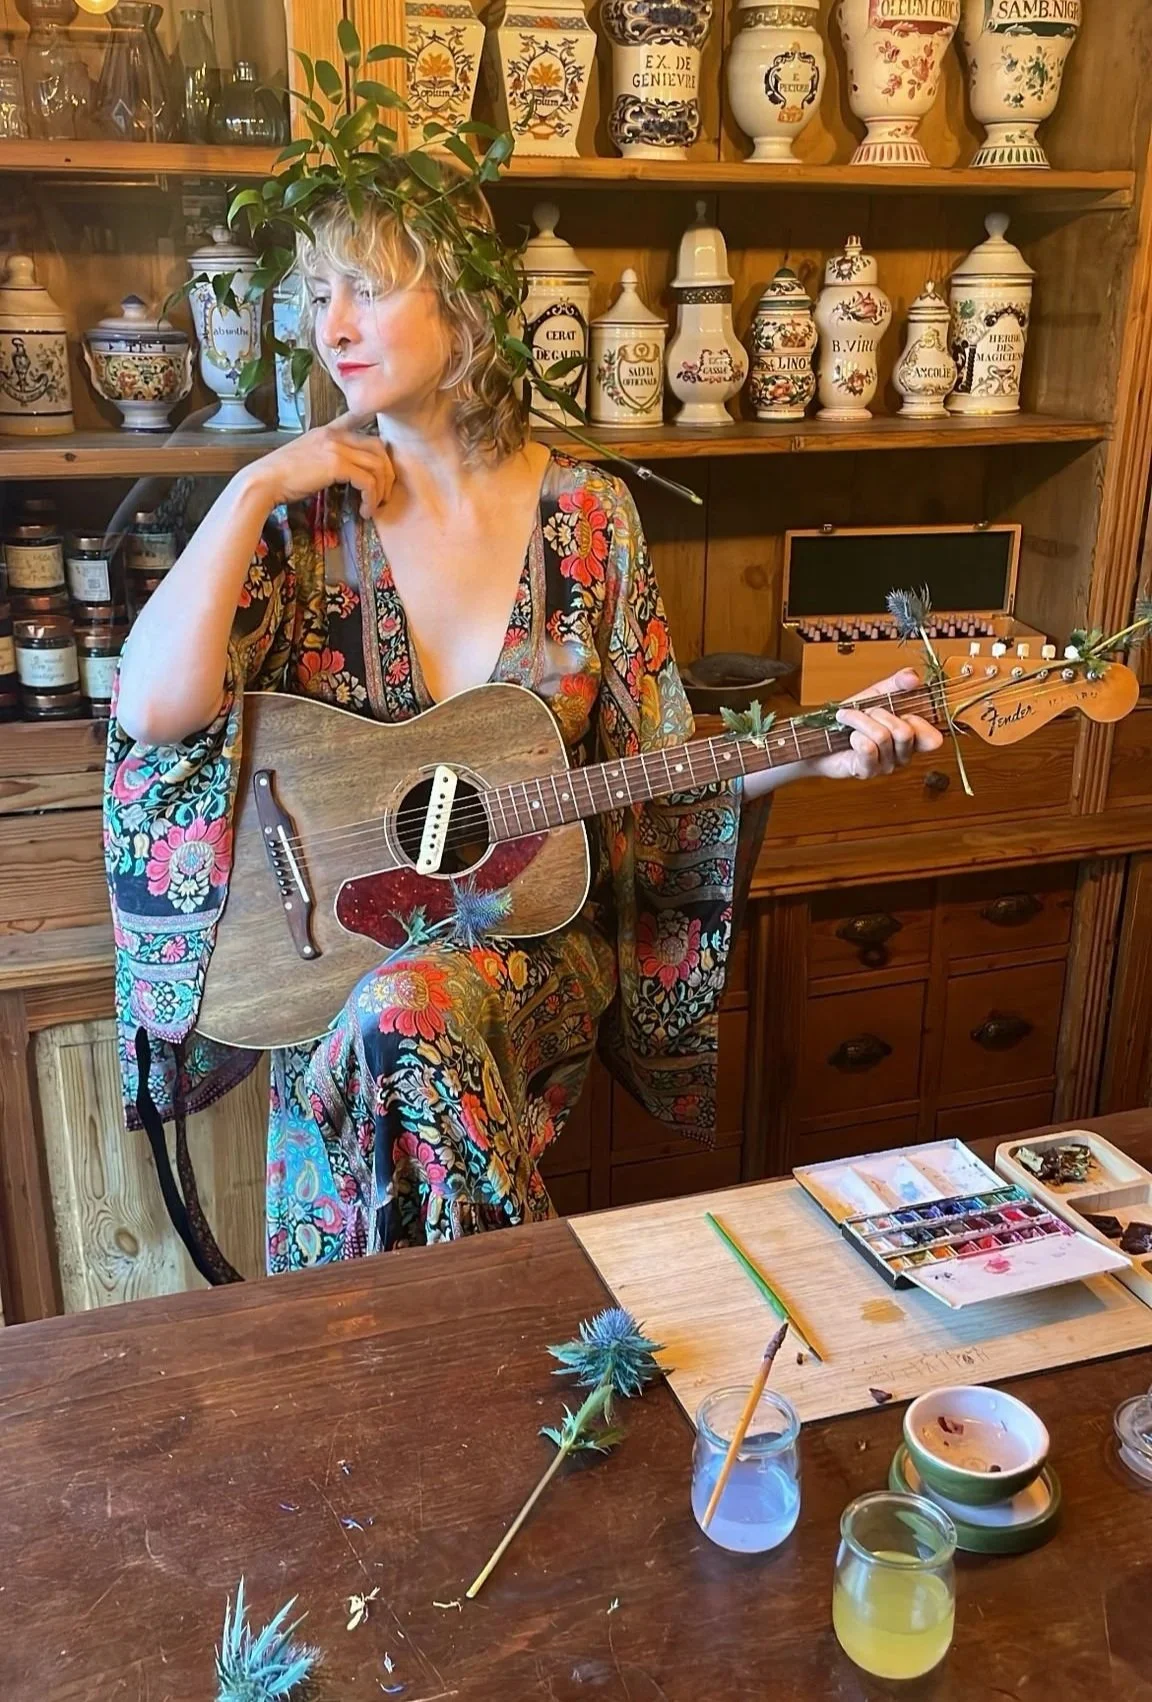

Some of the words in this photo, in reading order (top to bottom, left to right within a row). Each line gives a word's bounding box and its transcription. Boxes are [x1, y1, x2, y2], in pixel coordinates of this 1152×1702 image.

[645, 54, 672, 69] EX.
[675, 56, 692, 71] DE
[632, 72, 696, 88] GENIEVRE
[420, 89, 450, 103] opium
[533, 98, 559, 111] pium
[546, 331, 577, 341] CERAT
[996, 343, 1014, 352] DES
[536, 349, 551, 361] DE
[980, 701, 1036, 737] Fender
